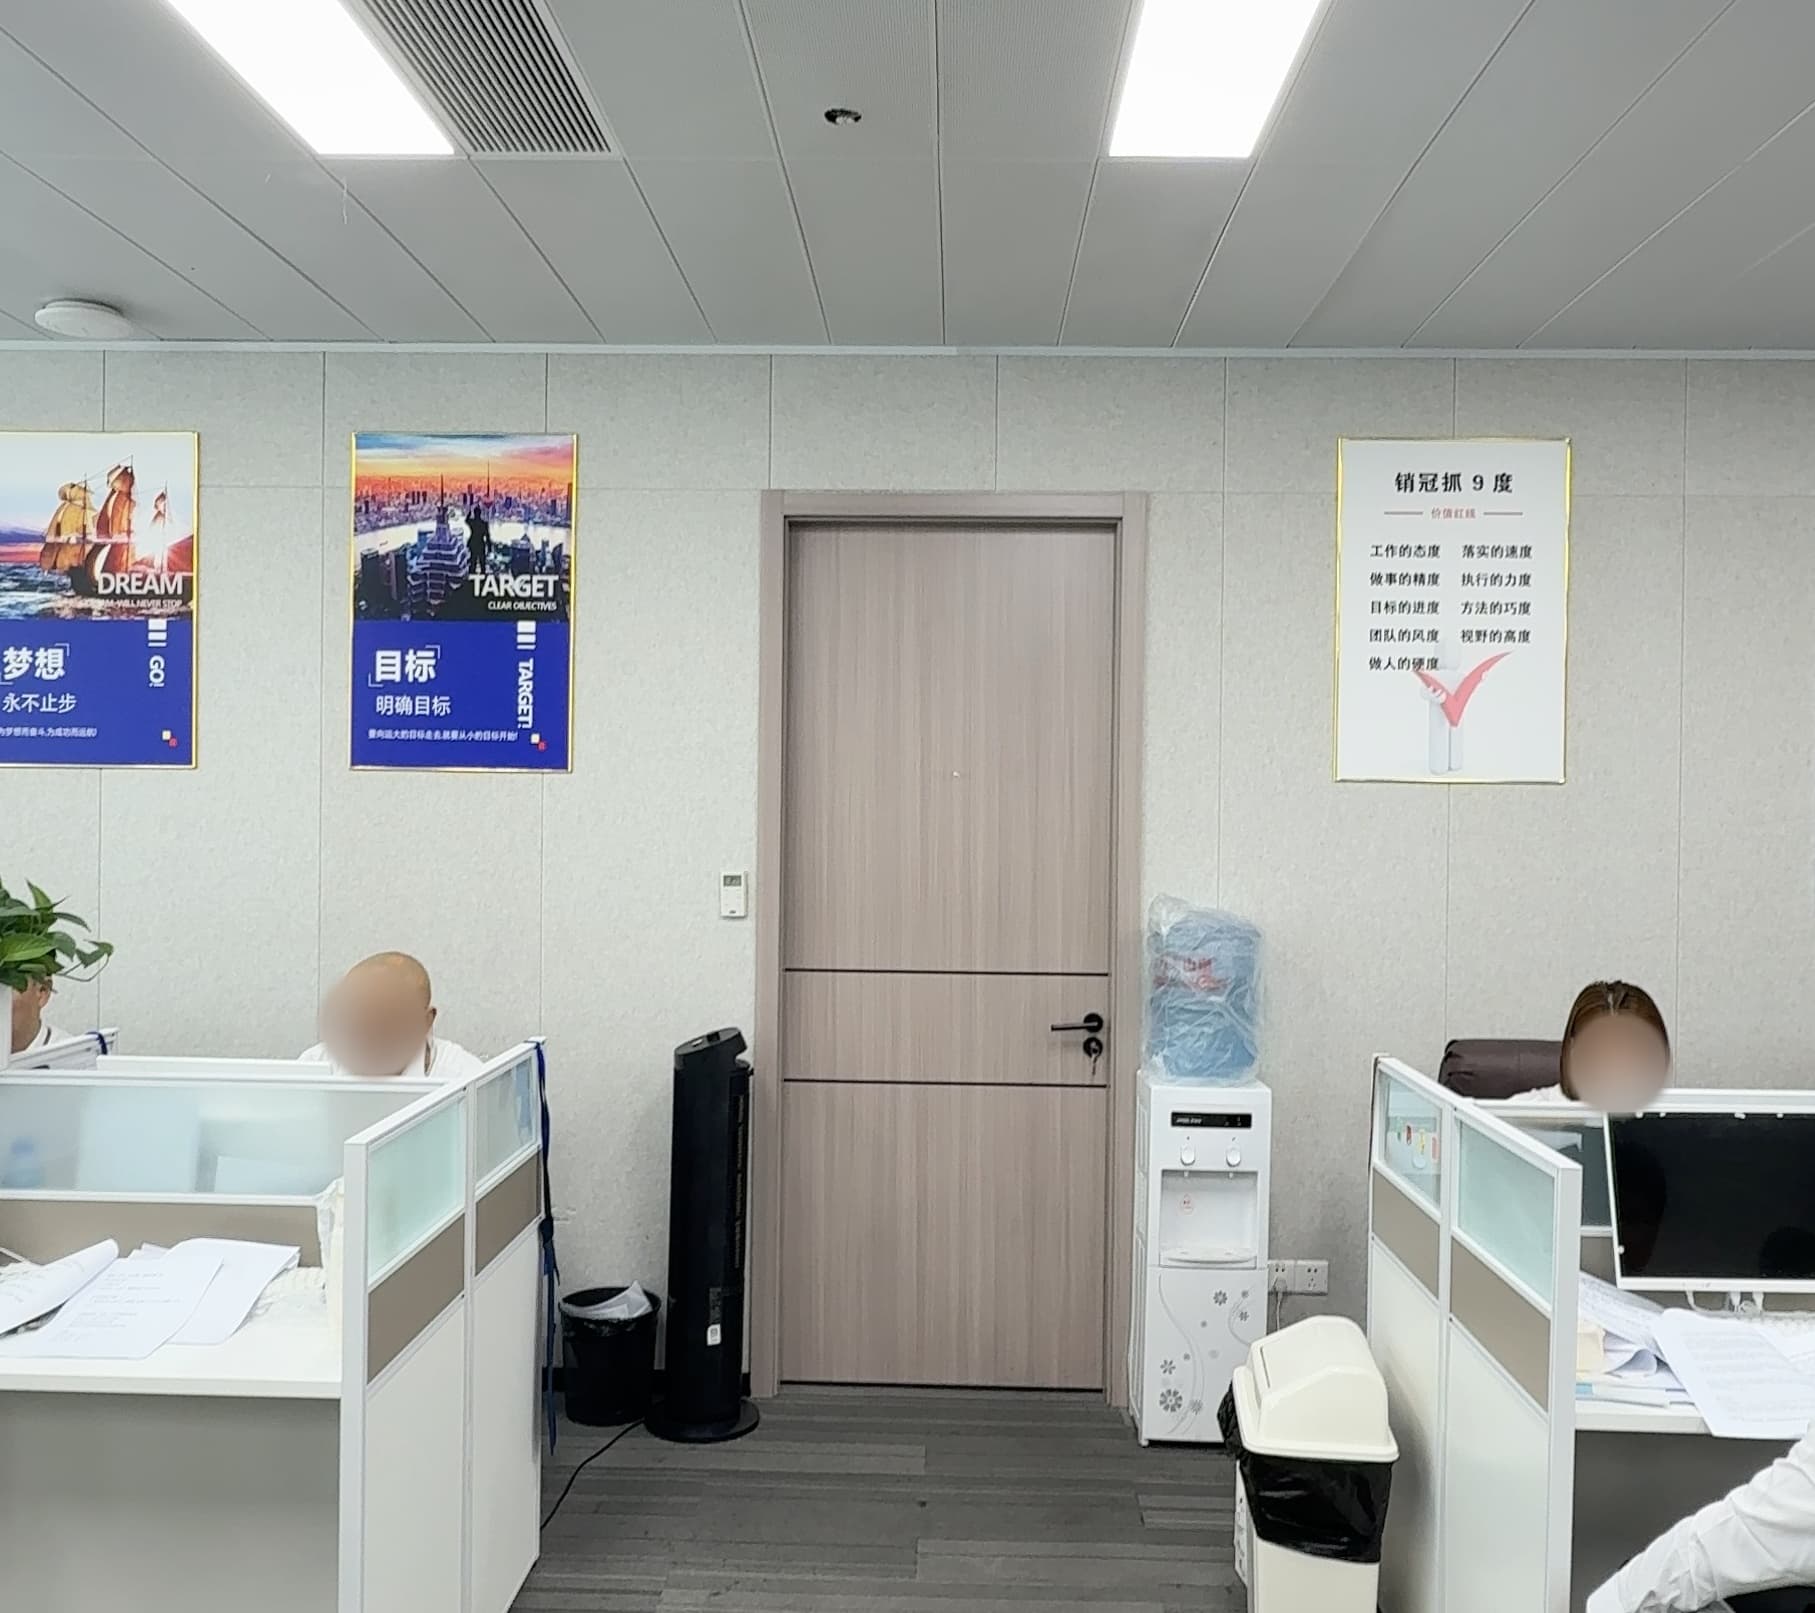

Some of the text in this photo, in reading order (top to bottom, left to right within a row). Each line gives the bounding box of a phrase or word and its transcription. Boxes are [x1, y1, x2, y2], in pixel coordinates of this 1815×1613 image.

[1394, 472, 1513, 493] 销冠抓 9 度
[1431, 507, 1476, 519] 价值红线
[1370, 544, 1441, 559] 工作的态度
[1462, 544, 1533, 559] 落实的速度
[98, 572, 183, 595] DREAM
[468, 573, 559, 598] TARGET
[1369, 572, 1440, 587] 做事的精度
[1461, 572, 1532, 587] 执行的力度
[487, 600, 558, 611] CLEAR OBJECTIVES
[1370, 600, 1440, 615] 目标的进度
[1461, 600, 1532, 616] 方法的巧度
[1368, 628, 1439, 643] 团队的风度
[1460, 629, 1531, 644] 视野的高度
[3, 646, 66, 680] 梦想
[375, 648, 437, 683] 目标
[1368, 656, 1439, 671] 做人的硬度
[149, 655, 165, 688] GO!
[517, 657, 534, 730] TARGET!
[2, 692, 77, 714] 永不止步
[376, 695, 451, 716] 明确目标
